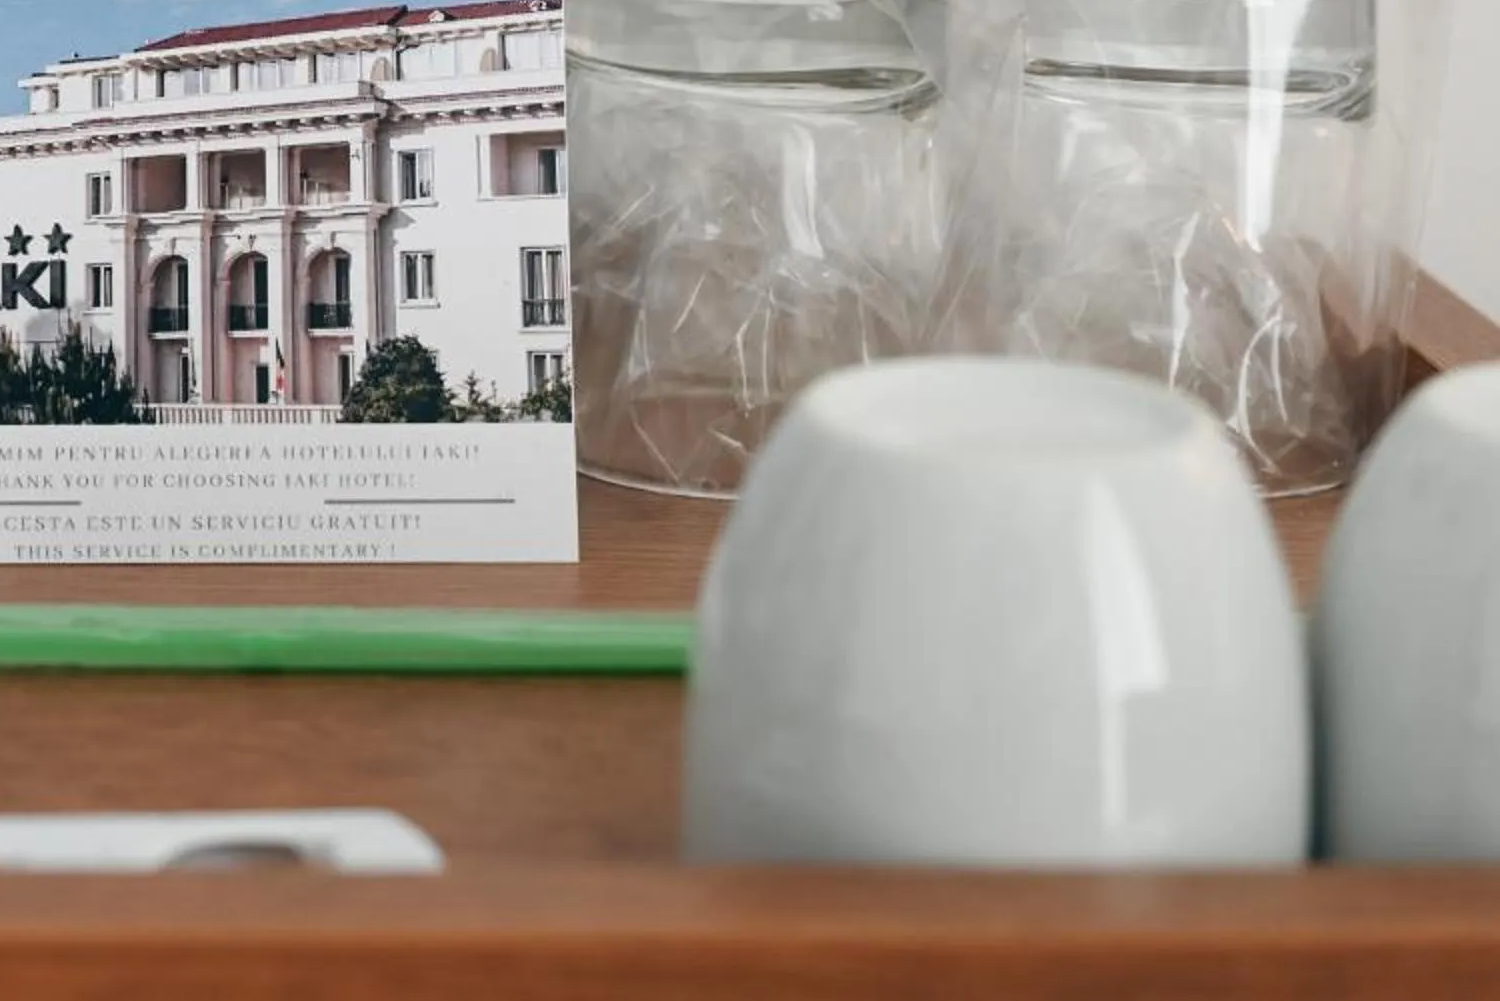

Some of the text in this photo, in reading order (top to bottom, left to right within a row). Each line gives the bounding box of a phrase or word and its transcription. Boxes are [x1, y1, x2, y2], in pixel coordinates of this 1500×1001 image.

[54, 445, 143, 461] PENTRU
[281, 444, 412, 460] HOTELULUI
[62, 474, 104, 489] YOU
[113, 474, 154, 489] FOR
[163, 473, 276, 488] CHOOSING
[284, 472, 329, 488] IAKI
[338, 472, 417, 488] HOTEL!
[86, 516, 143, 531] ESTE
[152, 516, 182, 531] UN
[191, 515, 300, 531] SERVICIU
[310, 514, 422, 530] GRATUIT!
[13, 545, 63, 559] THIS
[72, 544, 162, 559] SERVICE
[171, 544, 190, 558] IS
[198, 543, 382, 558] COMPLIMENTARY
